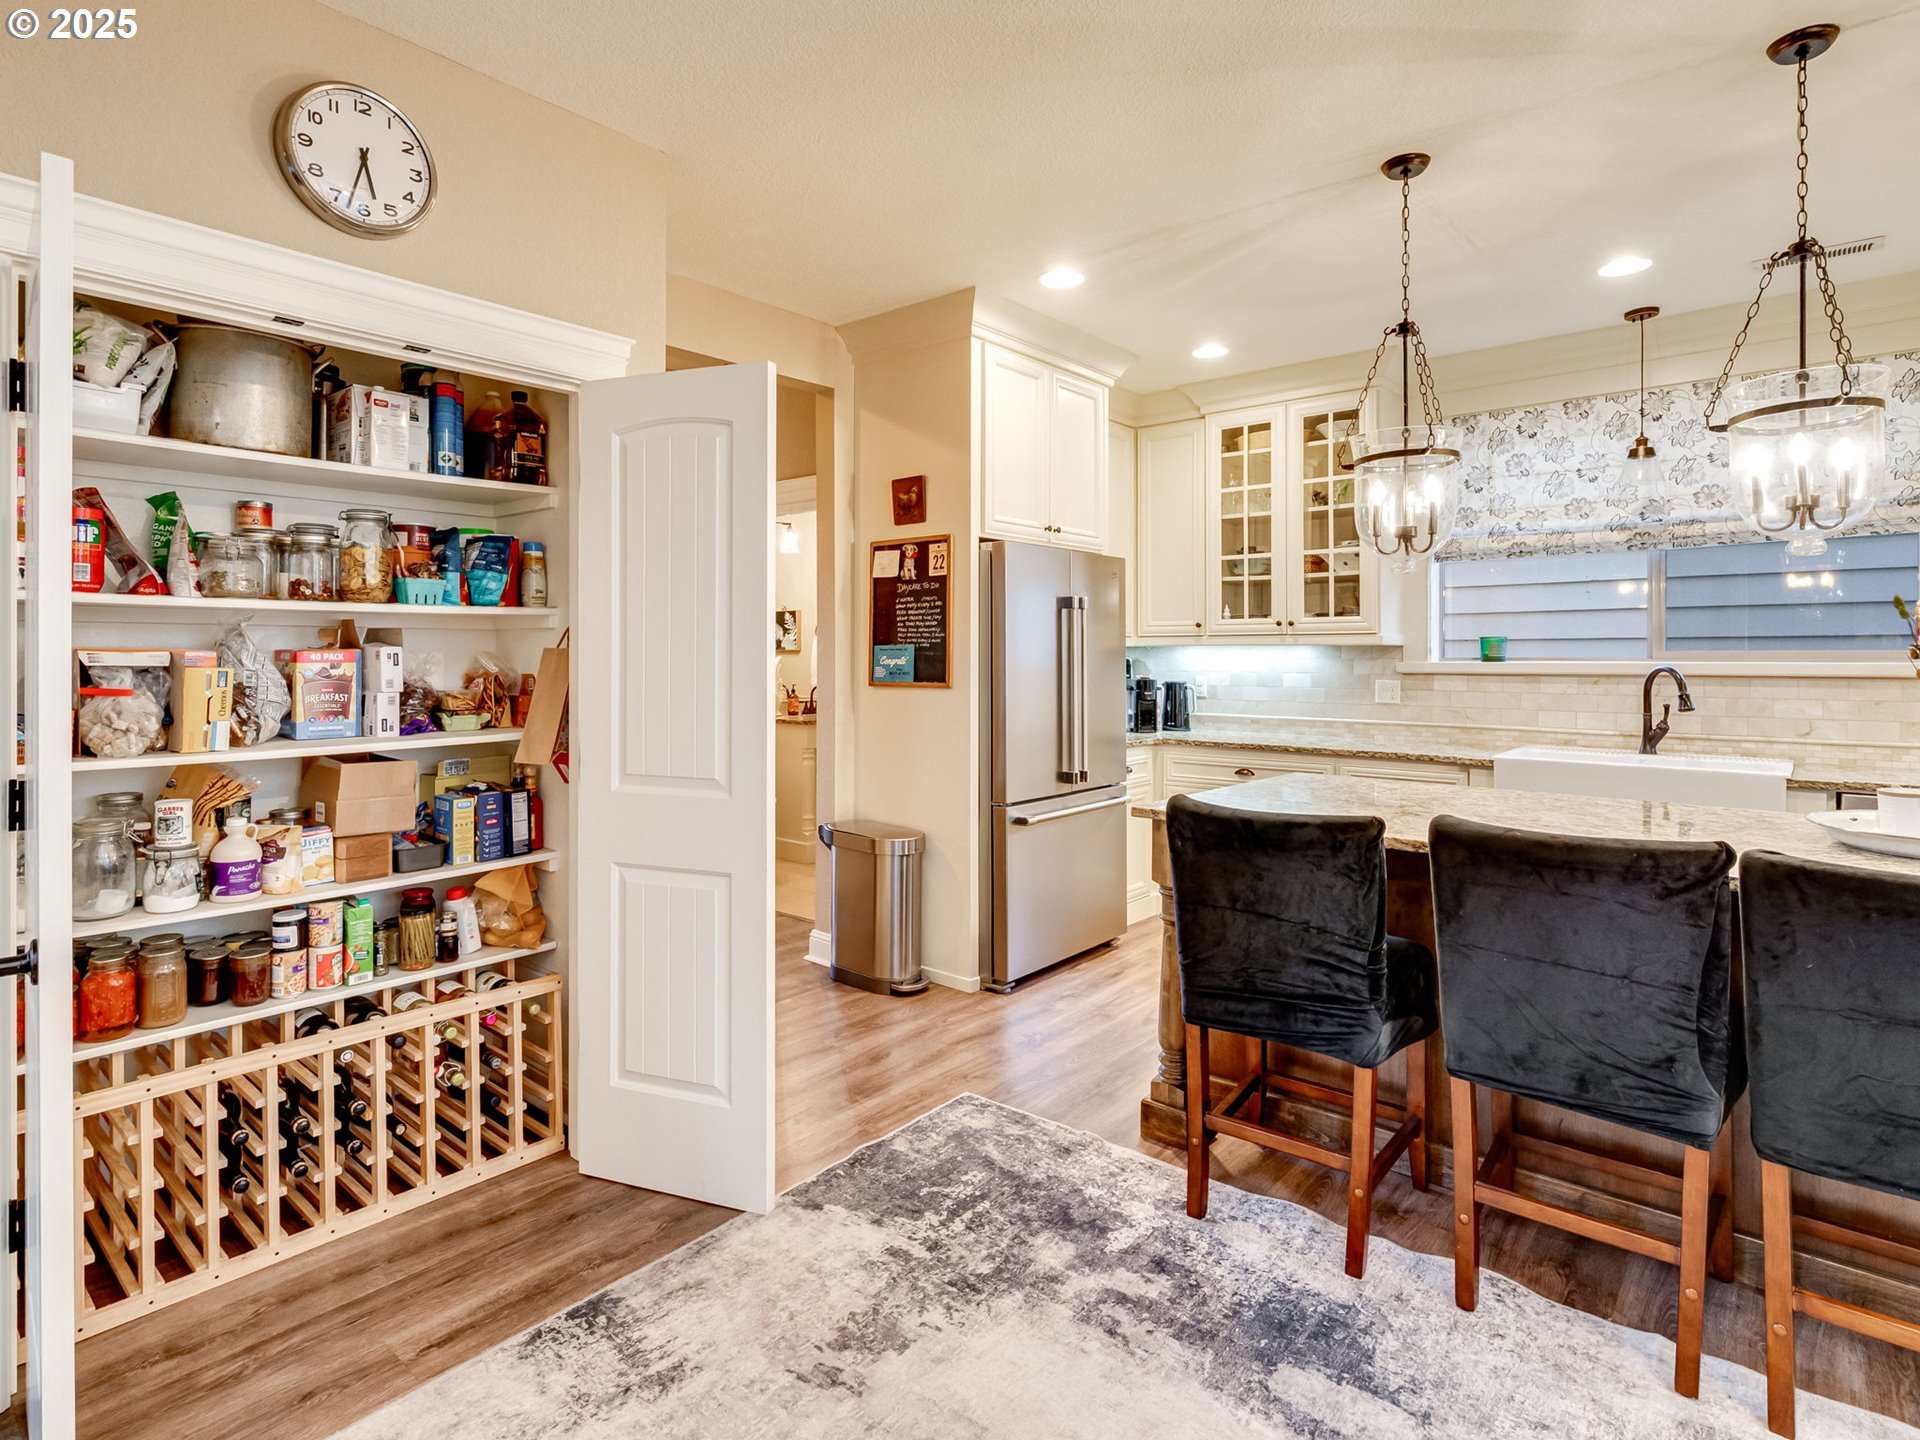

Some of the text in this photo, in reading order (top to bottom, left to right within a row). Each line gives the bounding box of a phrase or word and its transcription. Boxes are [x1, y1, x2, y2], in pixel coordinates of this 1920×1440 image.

[328, 98, 339, 114] 11
[354, 98, 372, 117] 12
[307, 109, 323, 125] 10
[297, 132, 313, 147] 9
[401, 141, 415, 156] 2
[307, 162, 324, 178] 8
[409, 168, 423, 183] 3
[329, 187, 342, 202] 7
[402, 191, 416, 204] 4
[356, 204, 371, 217] 6
[384, 203, 398, 217] 5
[152, 523, 175, 532] GANI
[932, 553, 945, 570] 22
[304, 693, 349, 704] BREAKFAST
[302, 836, 331, 848] JIFFY
[227, 862, 256, 875] Panache
